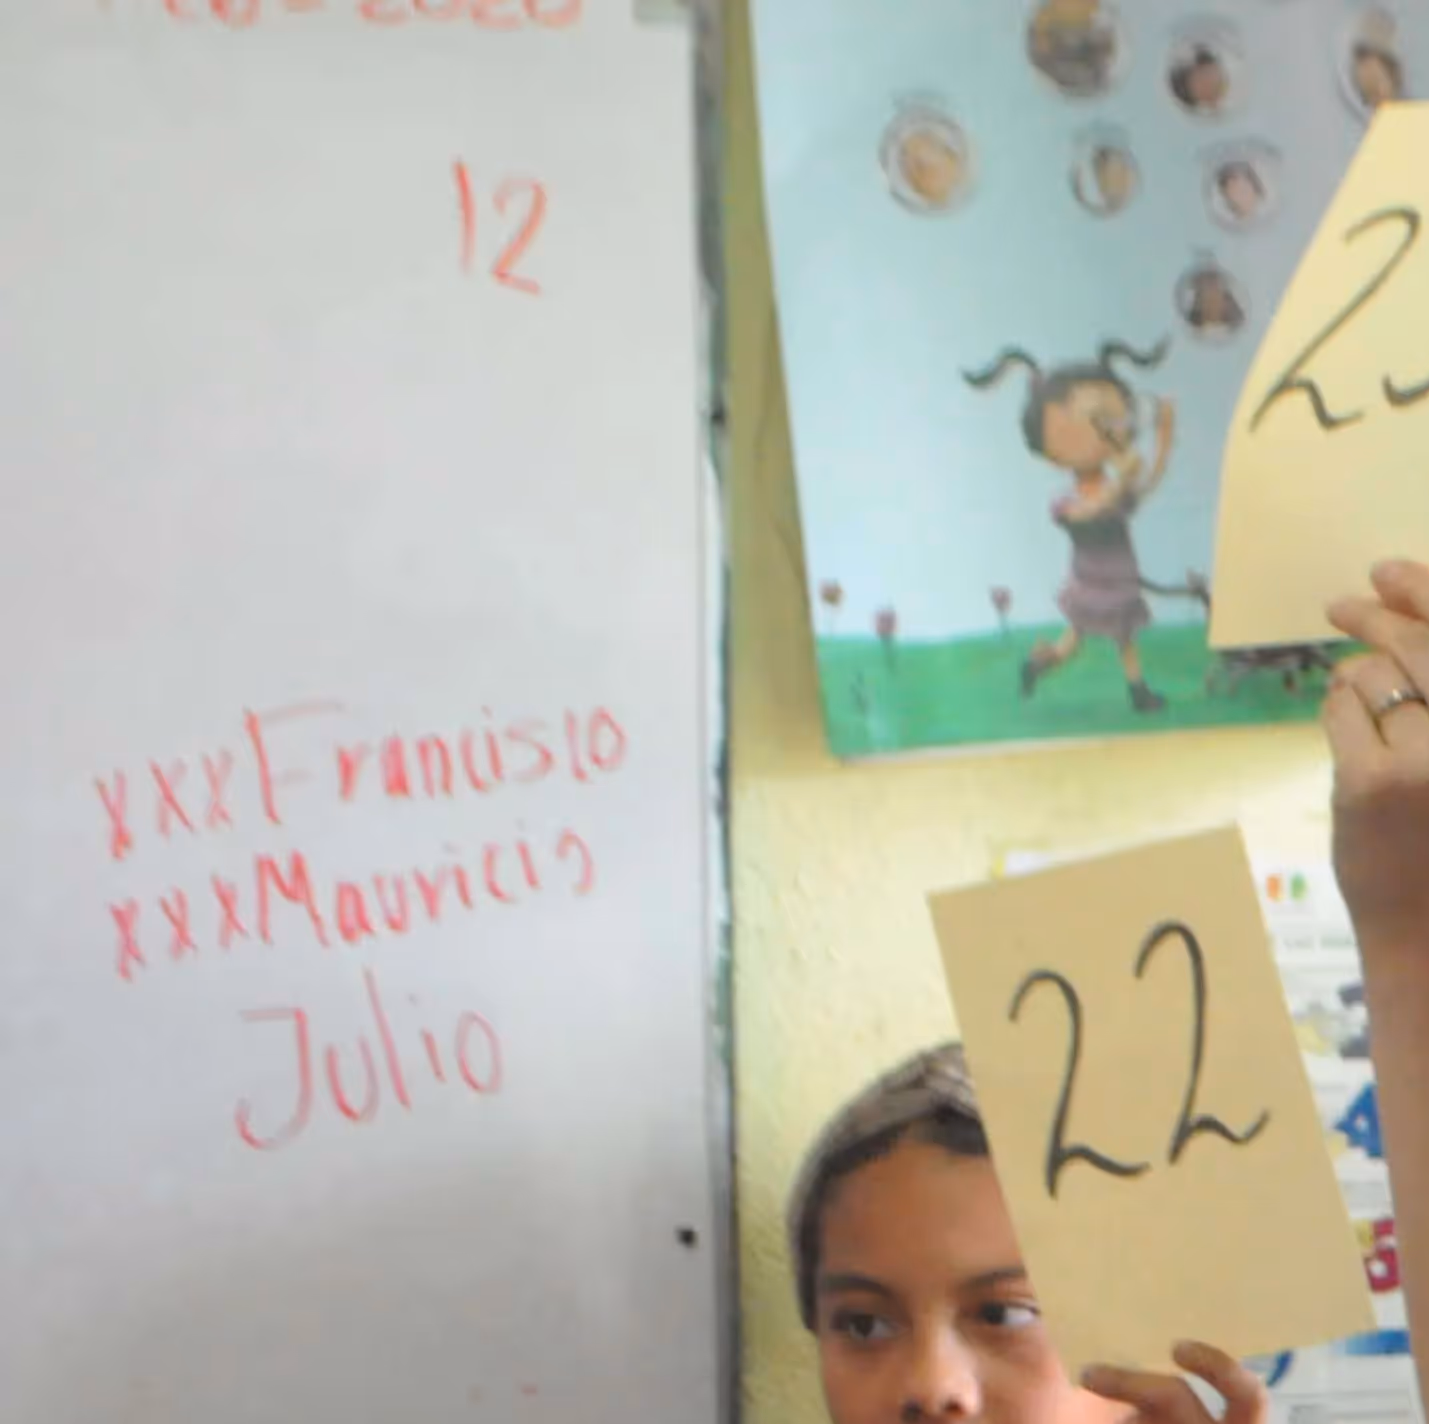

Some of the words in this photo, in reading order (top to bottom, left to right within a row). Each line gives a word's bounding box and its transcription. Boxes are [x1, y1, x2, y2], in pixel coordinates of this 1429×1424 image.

[453, 155, 549, 296] 12
[234, 966, 503, 1150] Julio
[1009, 918, 1270, 1199] 22
